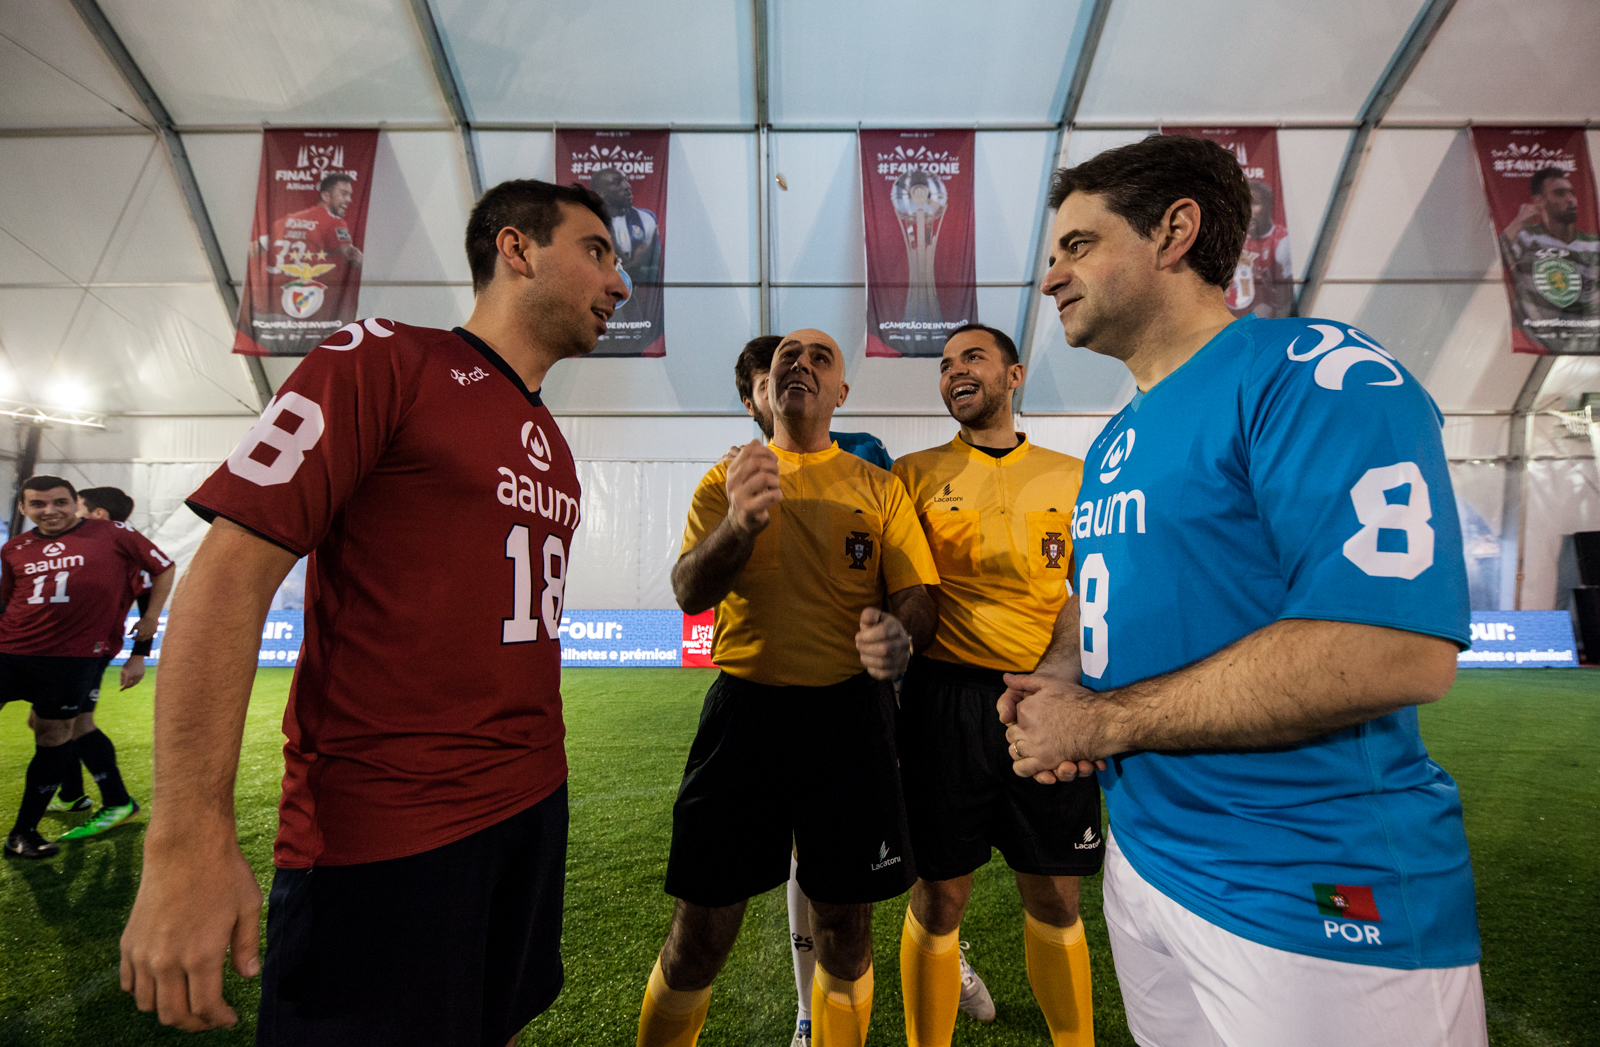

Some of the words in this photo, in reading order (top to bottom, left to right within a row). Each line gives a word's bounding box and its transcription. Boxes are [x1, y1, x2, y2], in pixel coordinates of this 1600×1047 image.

[275, 170, 314, 181] FINAL
[226, 391, 325, 487] 8
[496, 466, 580, 530] aaum
[1070, 489, 1146, 540] aaum
[1342, 461, 1435, 580] 8
[24, 555, 85, 575] aaum
[500, 522, 567, 645] 18
[27, 570, 71, 605] 11
[558, 617, 623, 640] Four:
[1079, 553, 1110, 680] 8
[609, 650, 619, 660] e
[620, 647, 678, 663] prémios!
[1323, 920, 1383, 946] POR
